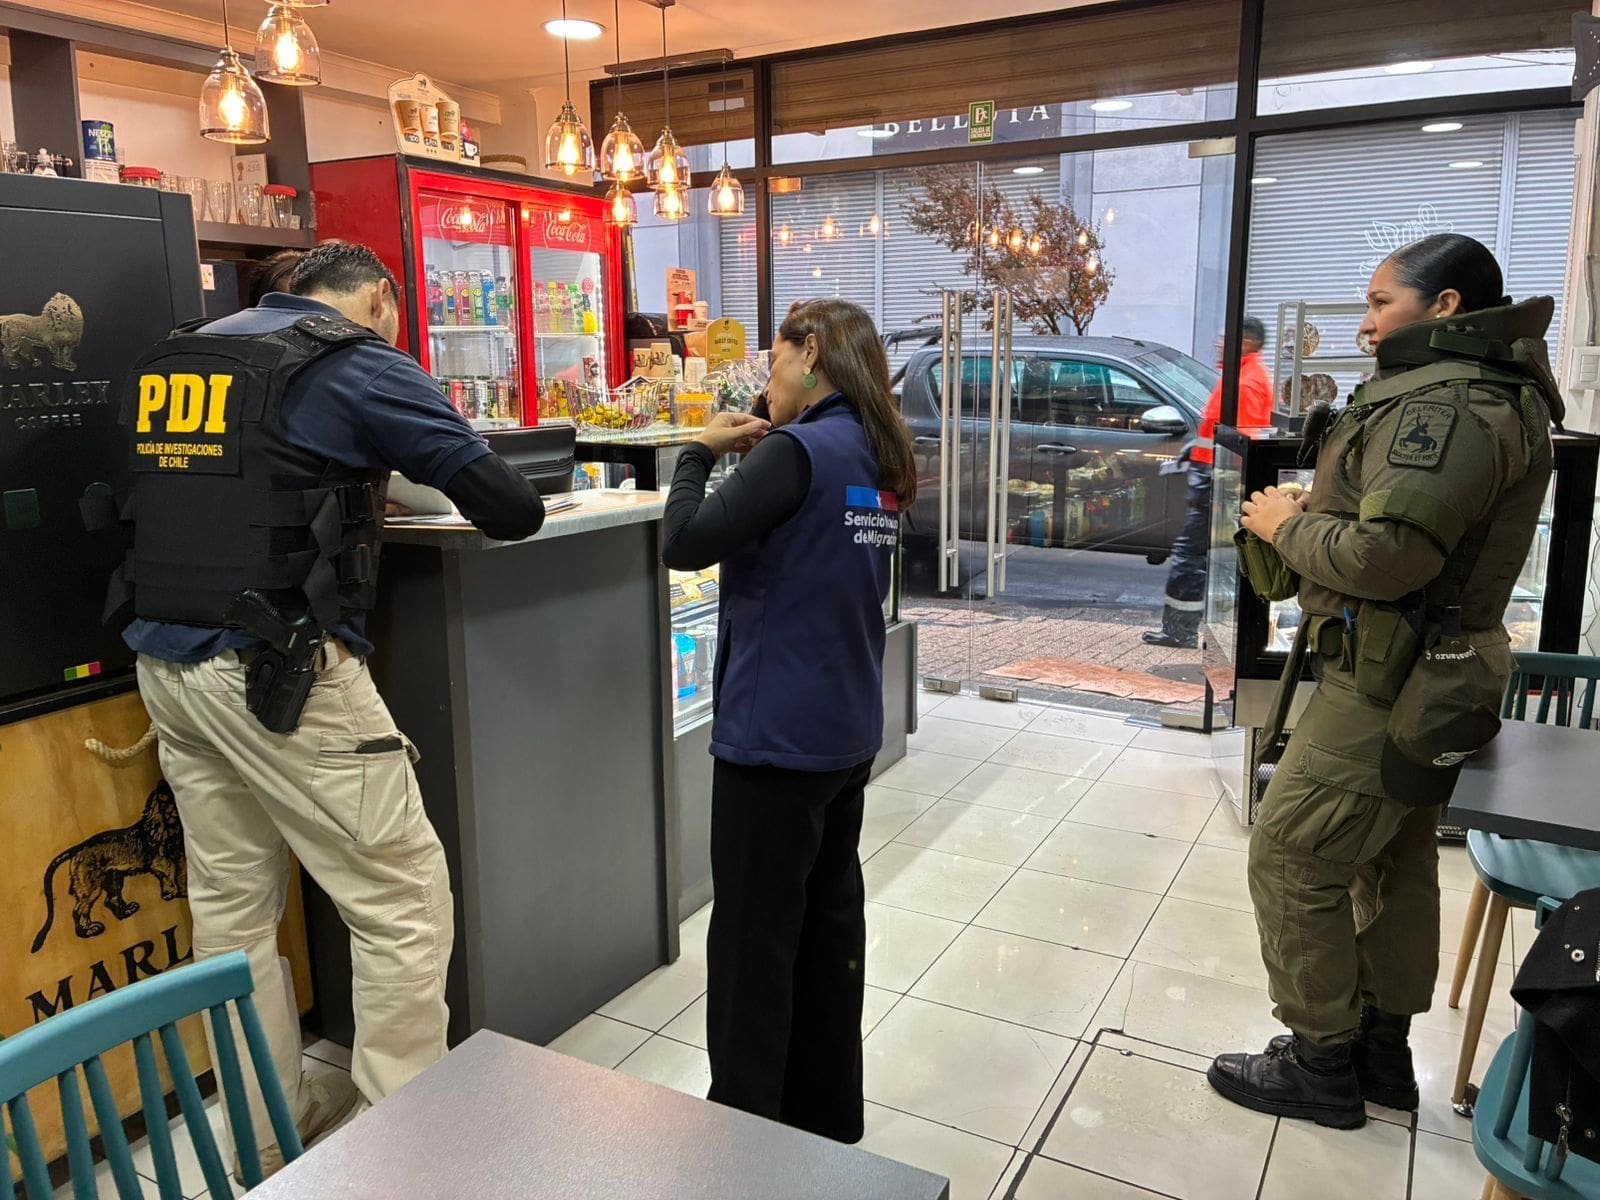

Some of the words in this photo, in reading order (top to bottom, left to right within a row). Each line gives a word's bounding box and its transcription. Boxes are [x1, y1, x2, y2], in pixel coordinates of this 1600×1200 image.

[884, 104, 1051, 134] BELLTA
[136, 373, 233, 434] PDI
[155, 443, 164, 454] DE
[164, 442, 223, 456] INVESTIGACIONES
[159, 456, 168, 468] DE
[168, 456, 189, 468] CHILE
[844, 511, 884, 528] Servicio
[853, 529, 867, 543] de
